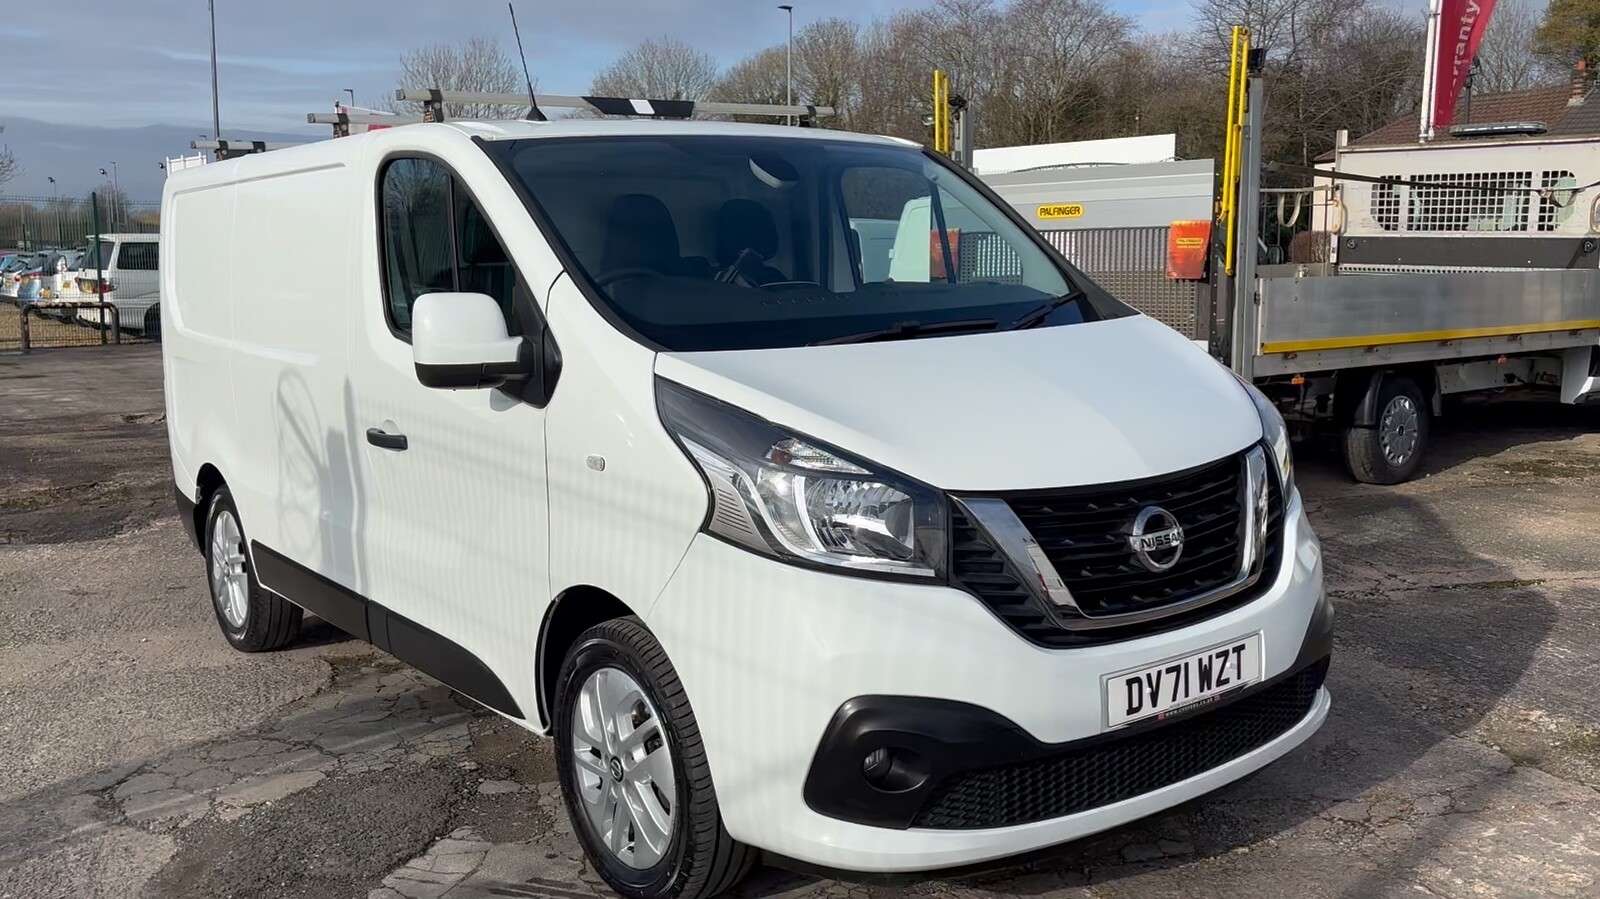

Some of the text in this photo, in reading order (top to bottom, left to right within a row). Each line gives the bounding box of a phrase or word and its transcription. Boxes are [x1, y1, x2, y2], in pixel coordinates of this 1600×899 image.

[1450, 0, 1480, 98] rranty
[1039, 206, 1081, 216] PALFINGER
[1140, 531, 1184, 549] NISSAN
[1126, 643, 1246, 716] DV71 WZT
